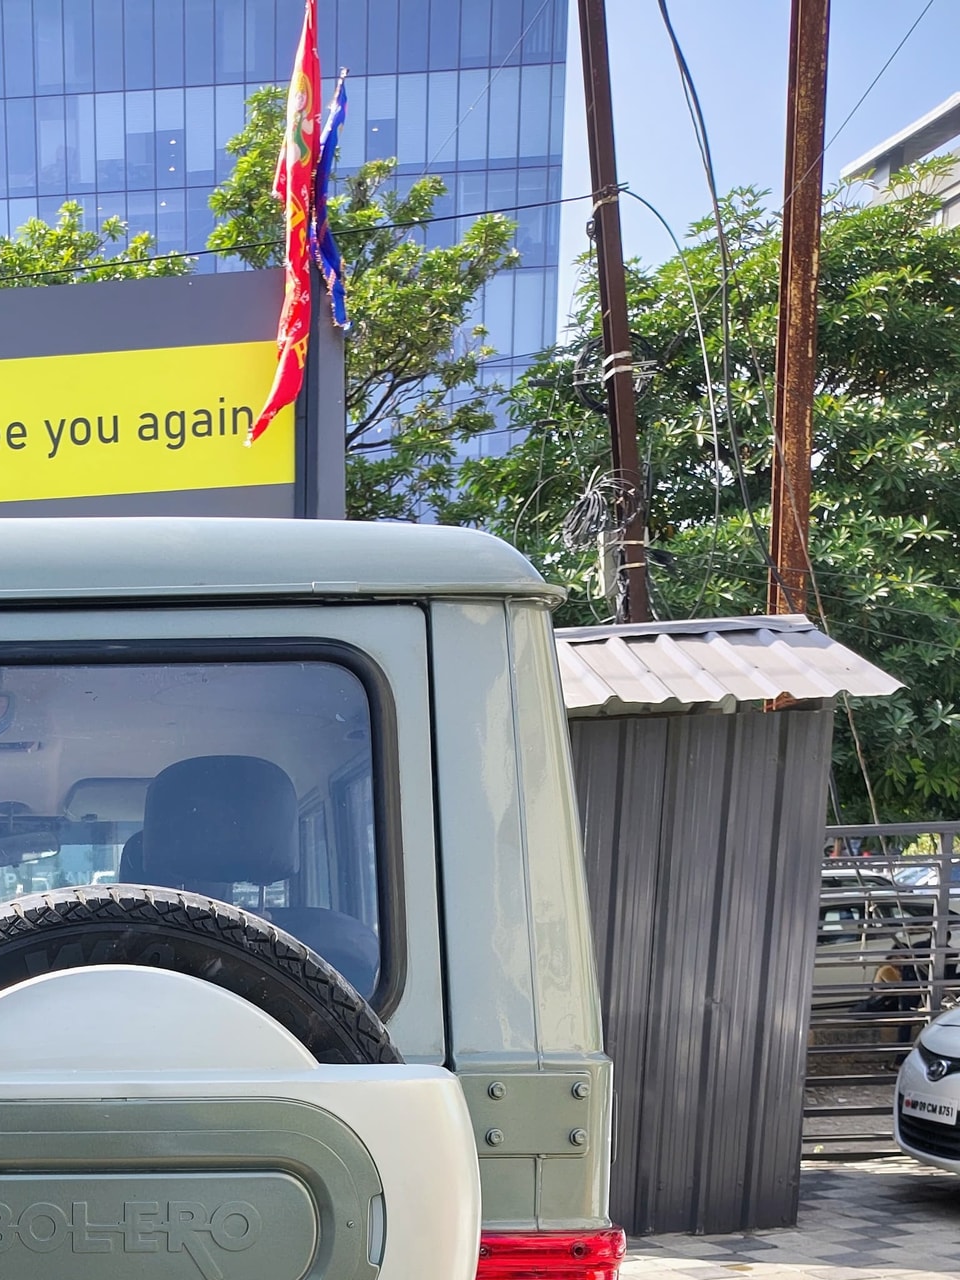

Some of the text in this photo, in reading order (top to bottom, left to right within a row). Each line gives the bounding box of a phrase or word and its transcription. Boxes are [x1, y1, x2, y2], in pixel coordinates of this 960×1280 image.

[43, 413, 120, 459] you
[137, 396, 254, 447] again
[926, 1103, 937, 1114] CM
